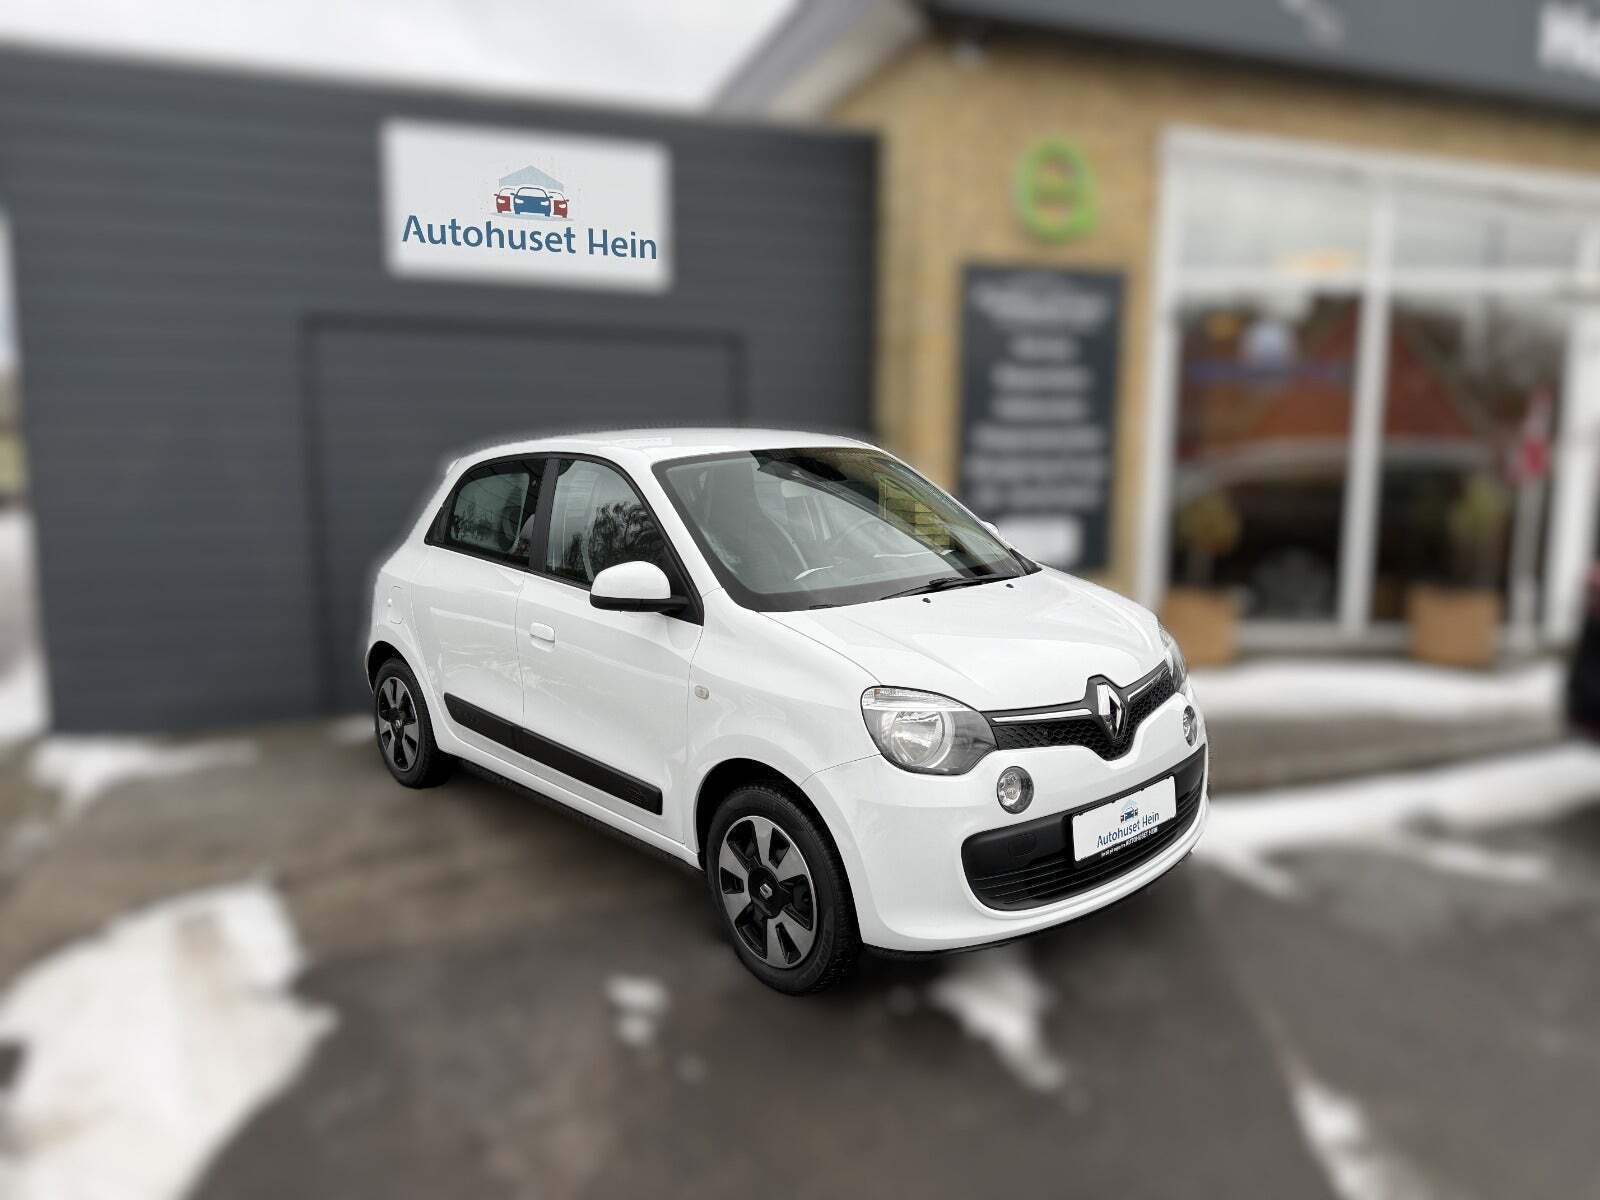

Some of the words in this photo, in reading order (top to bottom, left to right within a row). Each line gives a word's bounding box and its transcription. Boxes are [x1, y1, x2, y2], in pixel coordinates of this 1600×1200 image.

[402, 214, 576, 254] Autohuset
[588, 228, 657, 260] Hein
[1097, 820, 1140, 848] Autohuset
[1142, 812, 1160, 828] Hein
